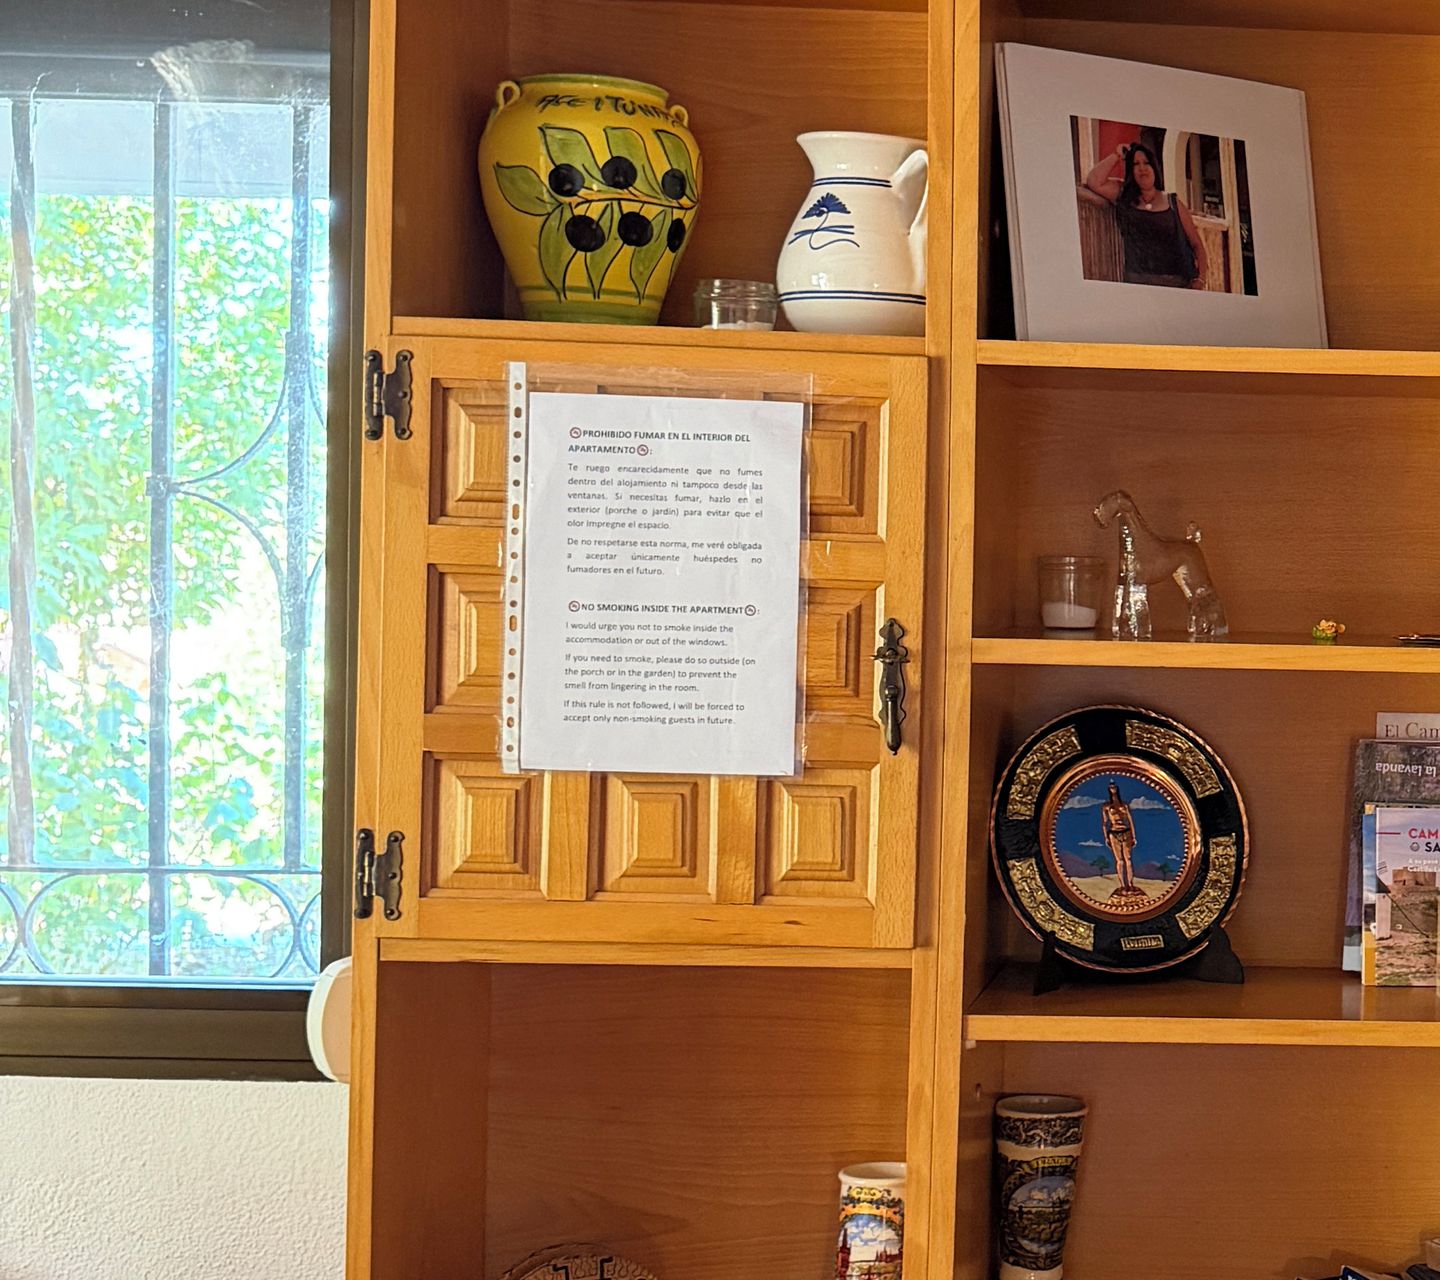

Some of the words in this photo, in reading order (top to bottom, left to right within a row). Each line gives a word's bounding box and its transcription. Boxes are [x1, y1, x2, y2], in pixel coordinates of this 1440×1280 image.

[582, 429, 632, 439] PROHIBIDO
[633, 431, 666, 440] FUMAR
[667, 432, 680, 441] EN
[681, 432, 691, 441] EL
[692, 432, 733, 442] INTERIOR
[734, 434, 751, 442] DEL
[568, 463, 578, 471] Te
[586, 465, 610, 474] ruego
[617, 464, 689, 475] encarecidamente
[696, 468, 712, 476] que
[737, 468, 763, 477] fumes
[568, 477, 596, 486] dentro
[600, 478, 613, 486] del
[617, 479, 667, 490] alojamiento
[671, 480, 678, 488] ni
[682, 481, 719, 491] tampoco
[723, 481, 747, 490] desde
[752, 482, 763, 490] las
[629, 493, 668, 502] necesitas
[674, 494, 702, 504] fumar,
[709, 495, 731, 503] hazlo
[755, 496, 763, 504] el
[567, 506, 601, 514] exterior
[605, 506, 638, 516] (porche
[683, 509, 702, 517] para
[706, 509, 730, 517] evitar
[734, 511, 751, 519] que
[754, 510, 763, 518] el
[566, 519, 585, 527] olor
[586, 520, 626, 530] impregne
[627, 520, 636, 528] el
[567, 537, 579, 546] De
[593, 538, 638, 548] respetarse
[640, 540, 658, 548] esta
[659, 541, 689, 549] norma,
[706, 540, 725, 549] veré
[726, 541, 762, 552] obligada
[585, 552, 617, 561] aceptar
[567, 565, 611, 574] fumadores
[626, 567, 634, 575] el
[636, 566, 665, 575] futuro.
[581, 603, 595, 611] NO
[597, 603, 639, 613] SMOKING
[641, 604, 669, 613] INSIDE
[671, 605, 687, 614] THE
[570, 621, 597, 630] would
[598, 623, 618, 632] urge
[619, 624, 635, 633] you
[664, 623, 692, 632] smoke
[693, 624, 718, 633] inside
[719, 625, 734, 633] the
[565, 635, 633, 645] accommodation
[645, 637, 660, 645] out
[661, 637, 671, 645] of
[672, 637, 686, 646] the
[688, 638, 728, 647] windows.
[565, 653, 571, 661] If
[572, 655, 589, 663] you
[590, 654, 612, 663] need
[613, 655, 623, 663] to
[624, 655, 655, 664] smoke,
[656, 655, 683, 665] please
[684, 656, 696, 664] do
[708, 656, 740, 666] outside
[564, 667, 579, 676] the
[580, 668, 605, 678] porch
[627, 669, 642, 677] the
[643, 669, 676, 680] garden)
[677, 670, 687, 678] to
[688, 670, 722, 680] prevent
[723, 671, 737, 679] the
[564, 681, 587, 689] smell
[588, 681, 609, 690] from
[610, 682, 647, 693] lingering
[658, 683, 673, 691] the
[564, 699, 570, 707] If
[571, 700, 587, 708] this
[589, 700, 606, 708] rule
[616, 701, 631, 709] not
[632, 701, 671, 711] followed,
[677, 702, 693, 710] will
[694, 702, 705, 710] be
[707, 702, 734, 711] forced
[563, 714, 591, 723] accept
[592, 714, 612, 723] only
[613, 714, 667, 725] non-smoking
[668, 716, 696, 726] guests
[697, 716, 705, 724] in
[1384, 724, 1400, 738] El
[1375, 762, 1422, 777] lavanda
[1425, 766, 1437, 781] la
